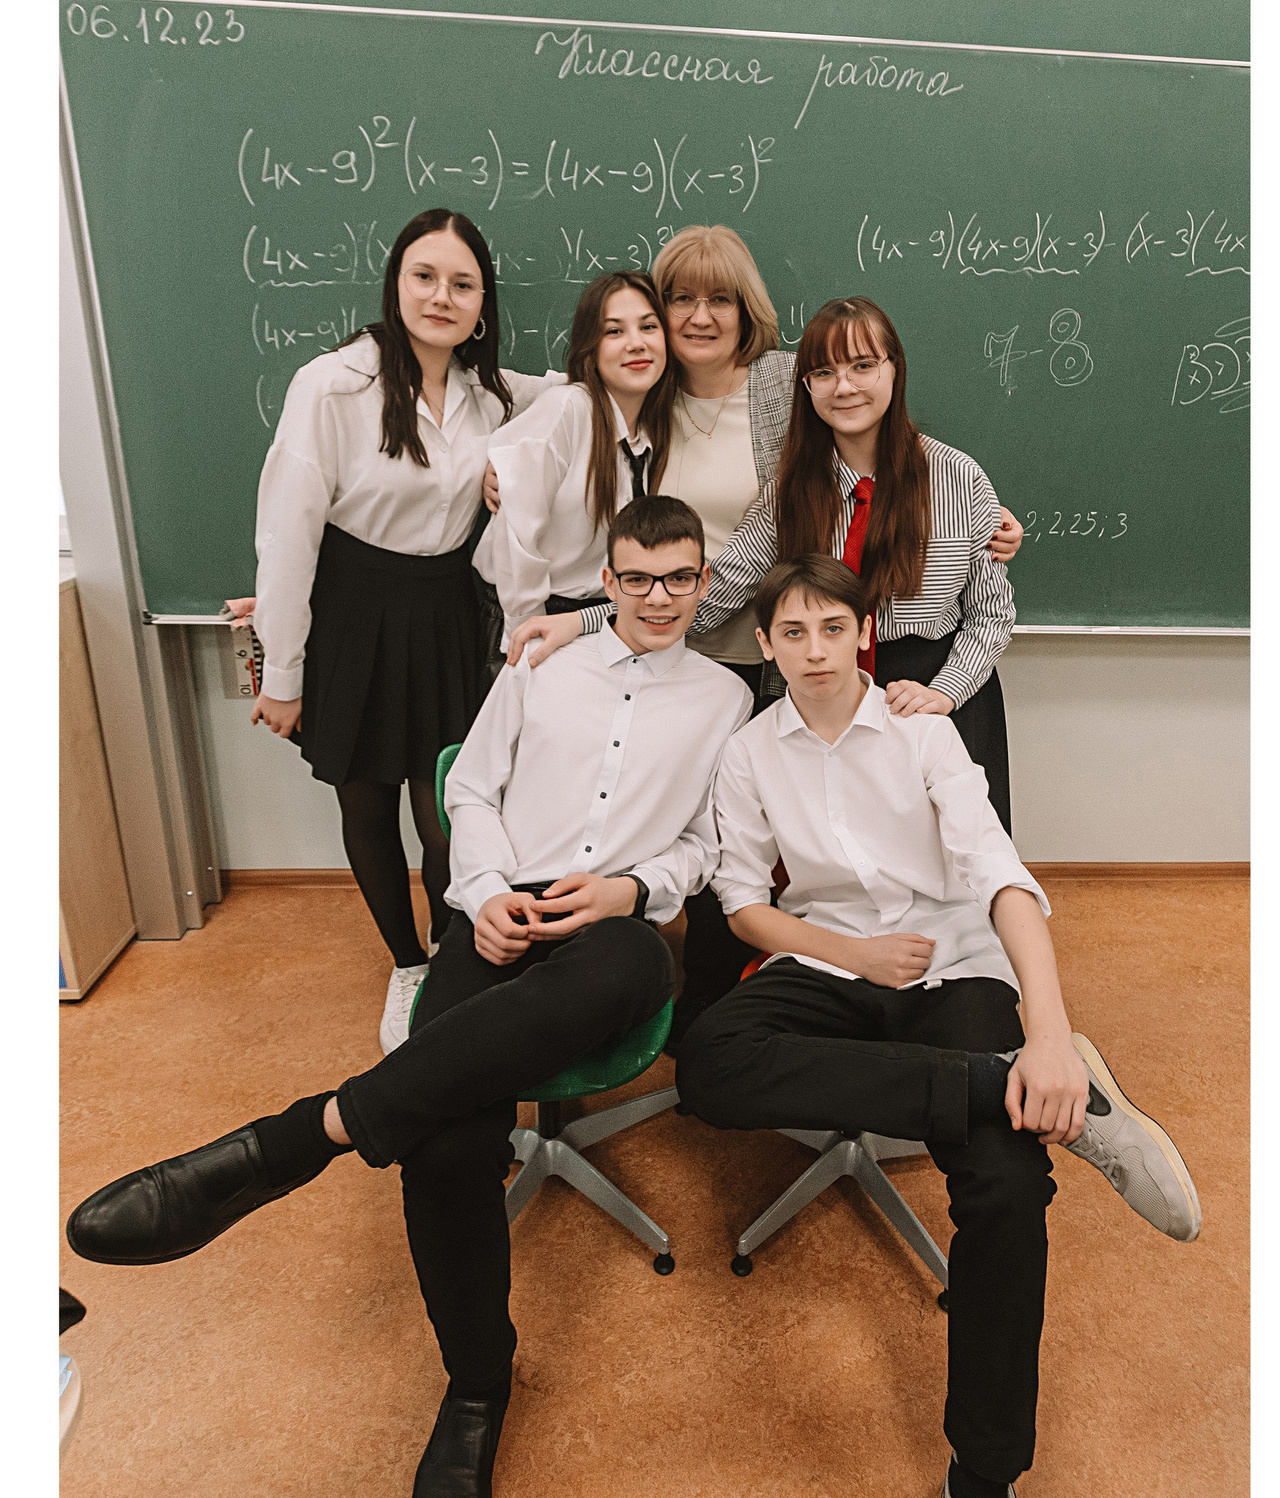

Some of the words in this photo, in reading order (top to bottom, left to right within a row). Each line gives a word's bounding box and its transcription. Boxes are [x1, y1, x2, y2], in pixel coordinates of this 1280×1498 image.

[66, 3, 245, 45] 06.12.23
[534, 27, 773, 84] Классная
[794, 54, 964, 130] работа
[239, 683, 251, 695] 10
